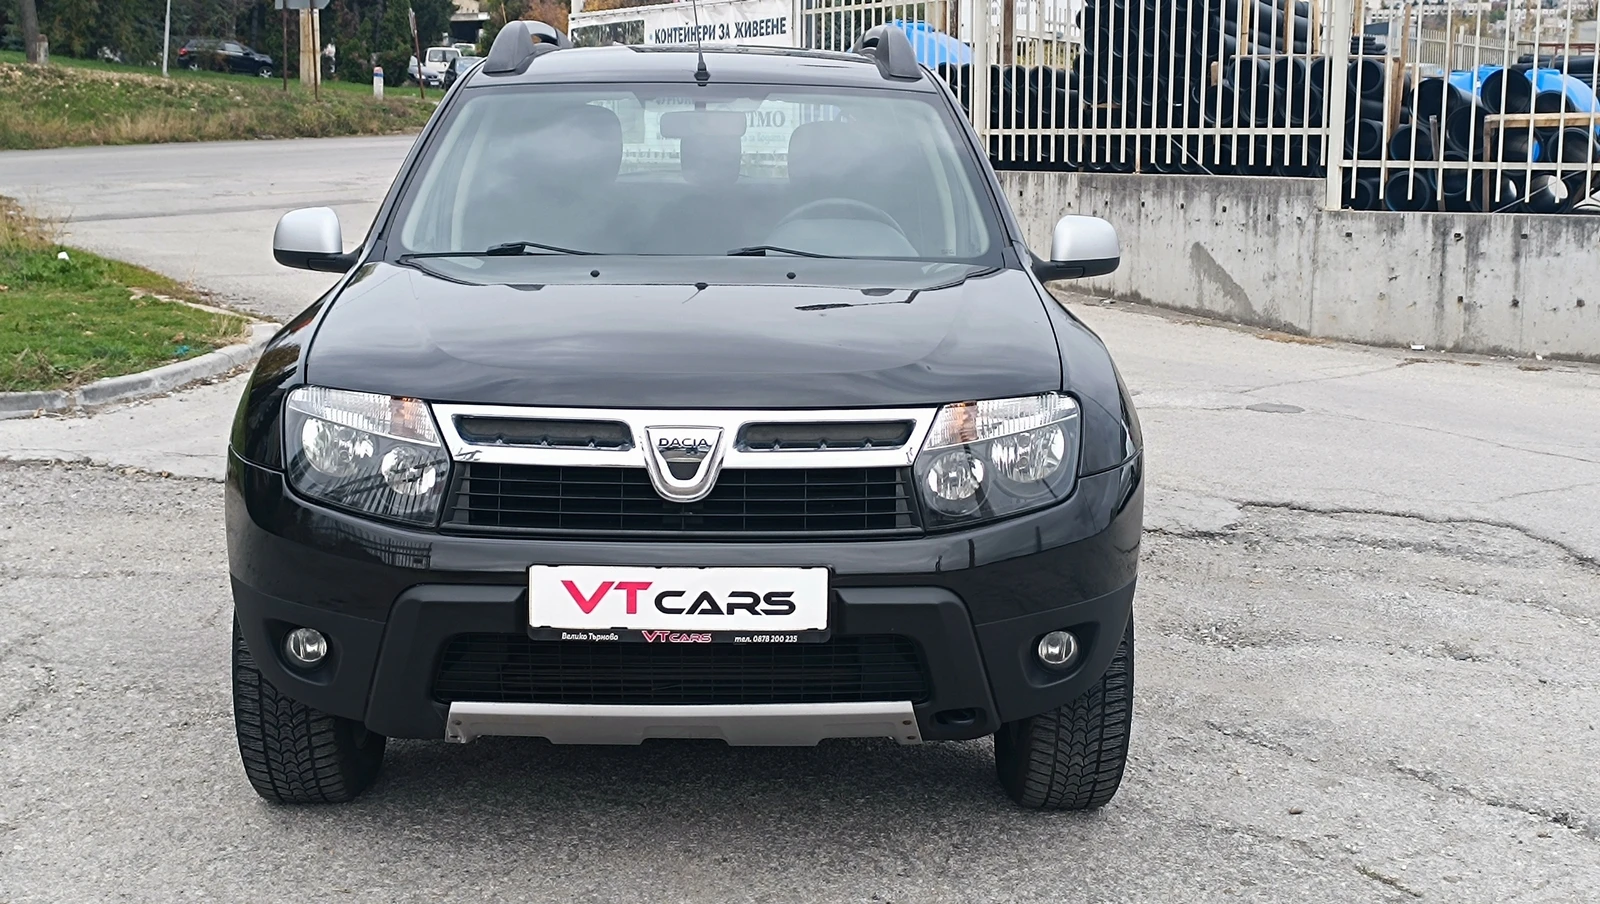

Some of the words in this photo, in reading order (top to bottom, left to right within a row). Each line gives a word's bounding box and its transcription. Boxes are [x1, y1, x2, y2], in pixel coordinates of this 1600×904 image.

[654, 21, 716, 44] КОНТЕЙНЕРИ
[719, 23, 731, 40] ЗА
[734, 17, 787, 38] ЖИВЕЕНЕ
[658, 437, 709, 447] DACIA
[561, 631, 588, 641] Велико
[588, 632, 619, 642] Търново
[734, 635, 752, 643] тел.
[752, 635, 770, 643] 0878
[770, 635, 785, 643] 200
[784, 635, 798, 643] 235
